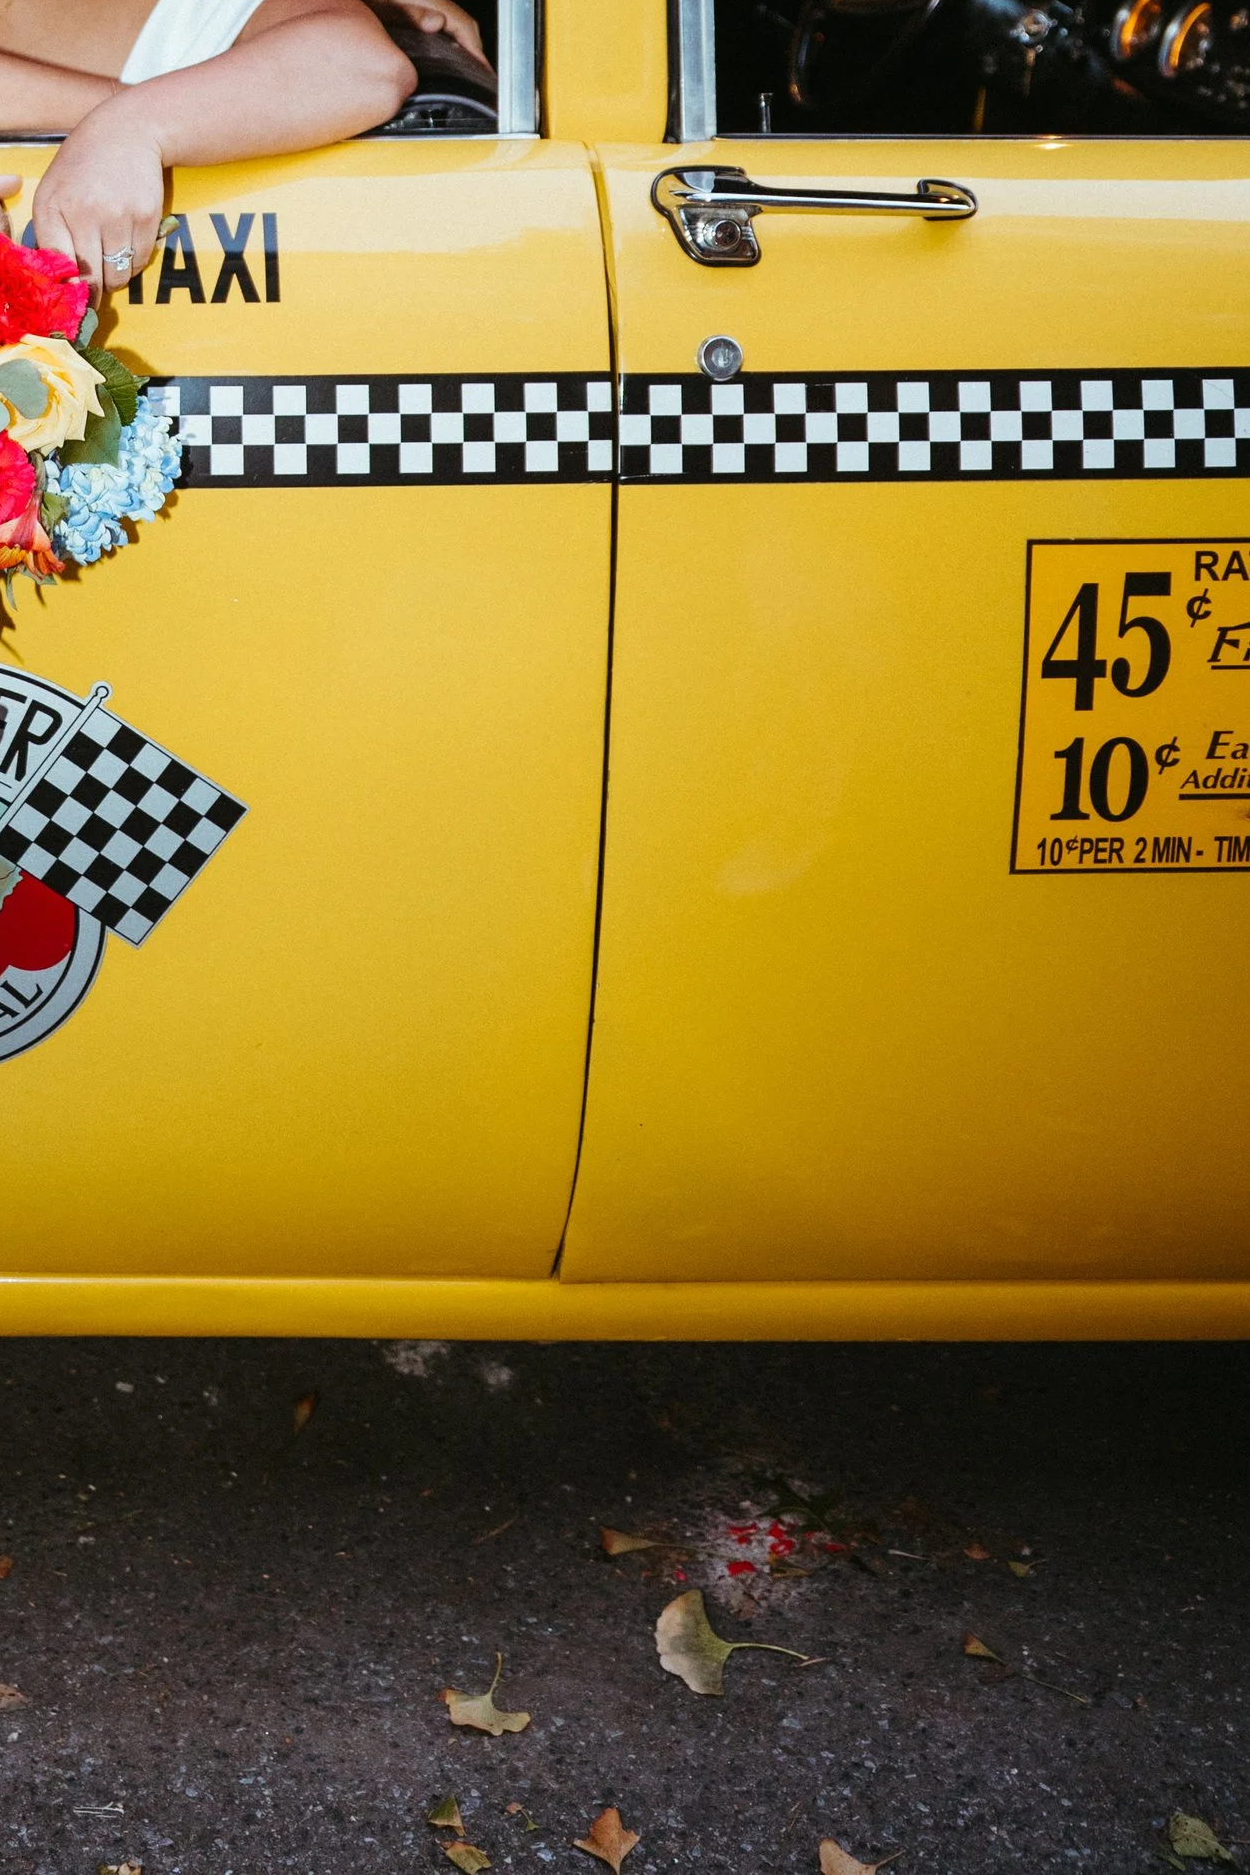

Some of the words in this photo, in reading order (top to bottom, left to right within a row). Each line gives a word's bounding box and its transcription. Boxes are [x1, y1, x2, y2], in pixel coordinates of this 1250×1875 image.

[1193, 549, 1250, 582] RA
[1205, 729, 1250, 760] Ea
[1179, 766, 1250, 790] Addi
